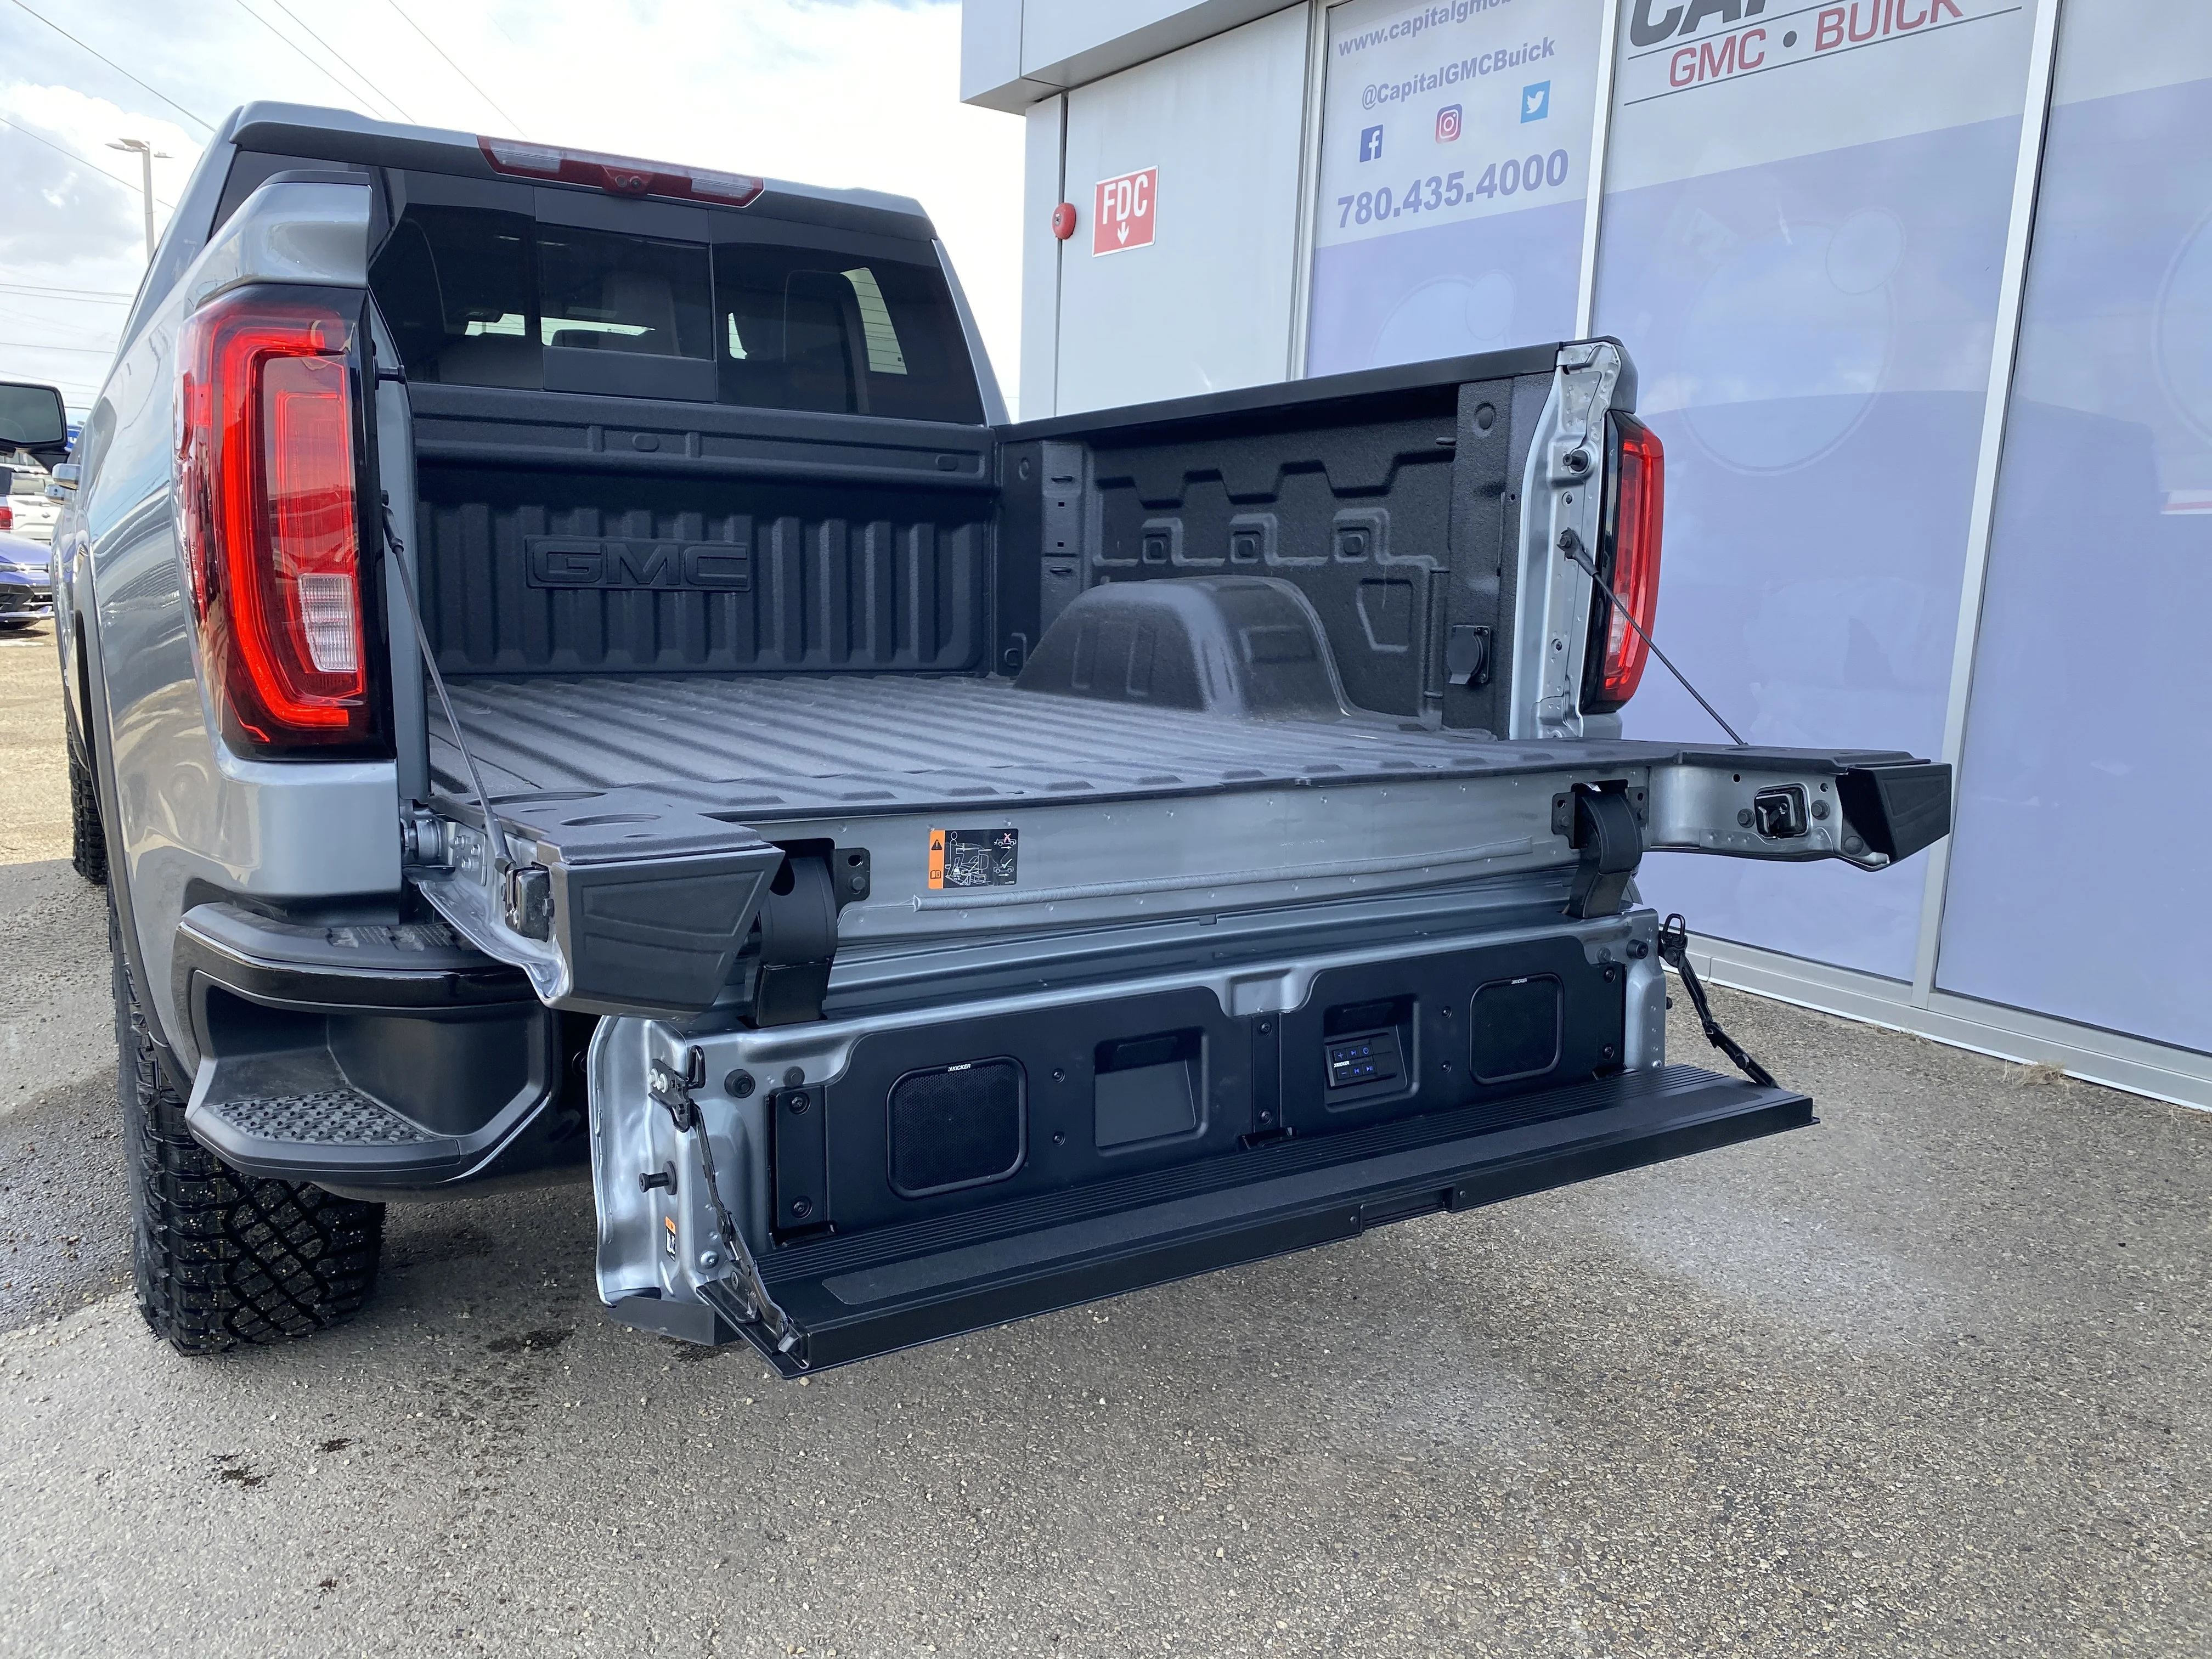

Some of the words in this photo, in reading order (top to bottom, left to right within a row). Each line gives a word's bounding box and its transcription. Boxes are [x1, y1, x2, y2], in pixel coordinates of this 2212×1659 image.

[1630, 0, 1765, 47] CA
[1669, 28, 1767, 87] GMC
[1815, 0, 1964, 52] BUICK
[1362, 36, 1556, 110] @CapitalGMCBuick
[1102, 174, 1149, 225] FDC
[1337, 149, 1569, 228] 780.435.4000
[533, 541, 748, 586] GMC
